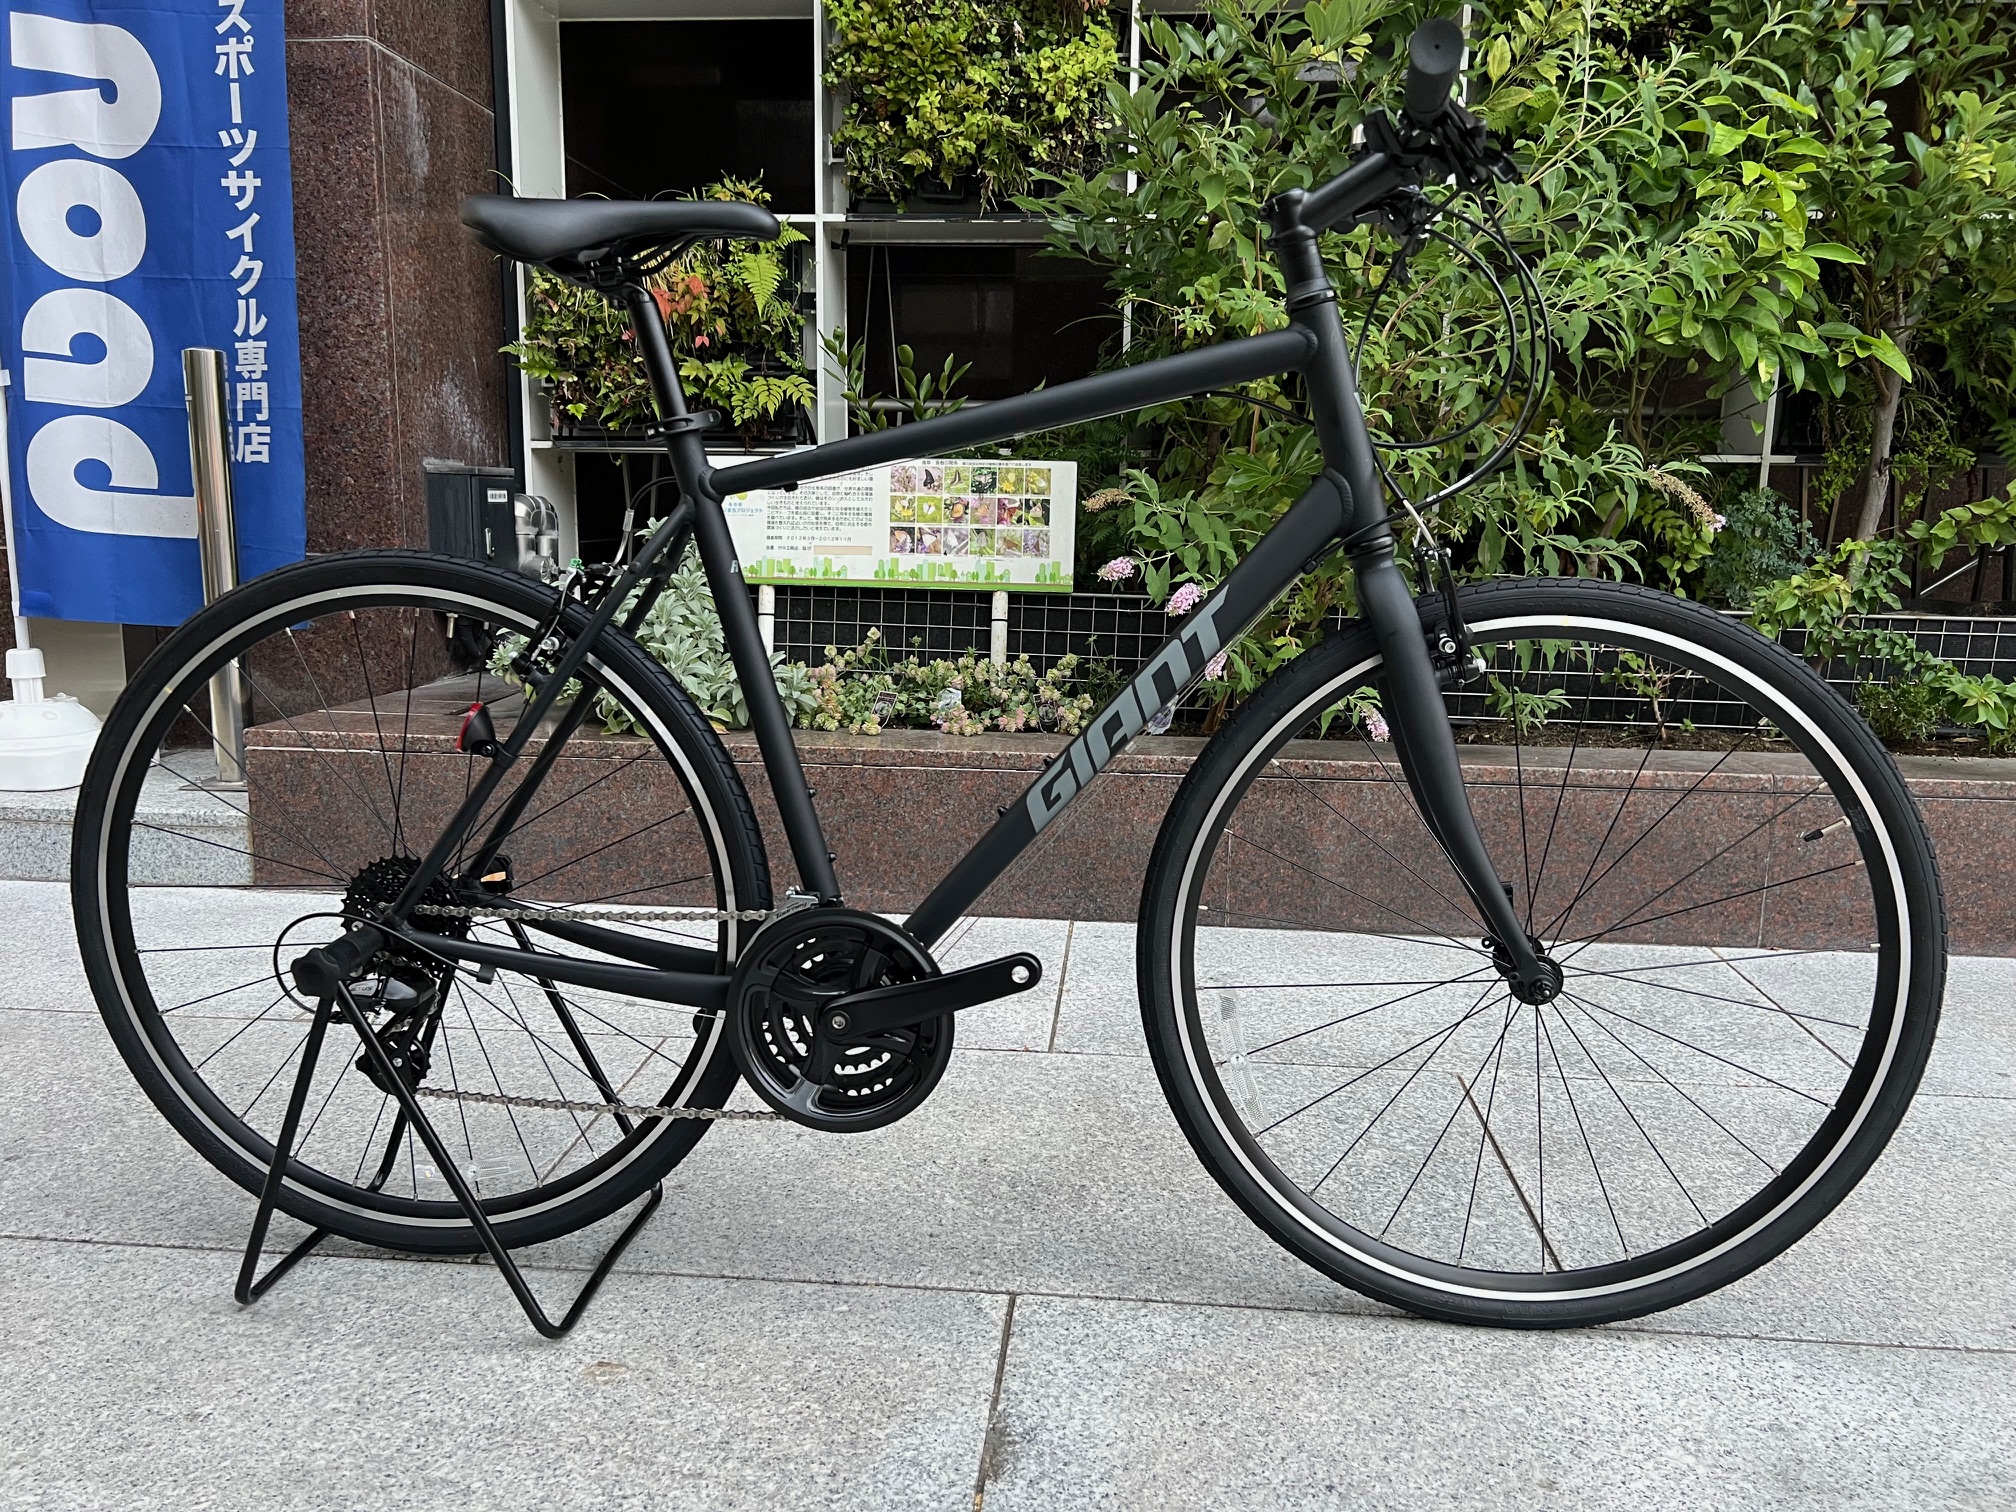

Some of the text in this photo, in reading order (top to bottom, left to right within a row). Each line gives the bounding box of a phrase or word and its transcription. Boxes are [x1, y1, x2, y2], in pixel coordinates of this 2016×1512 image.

[214, 0, 271, 464] スポーツサイクル専門店
[1026, 584, 1230, 834] GIANT
